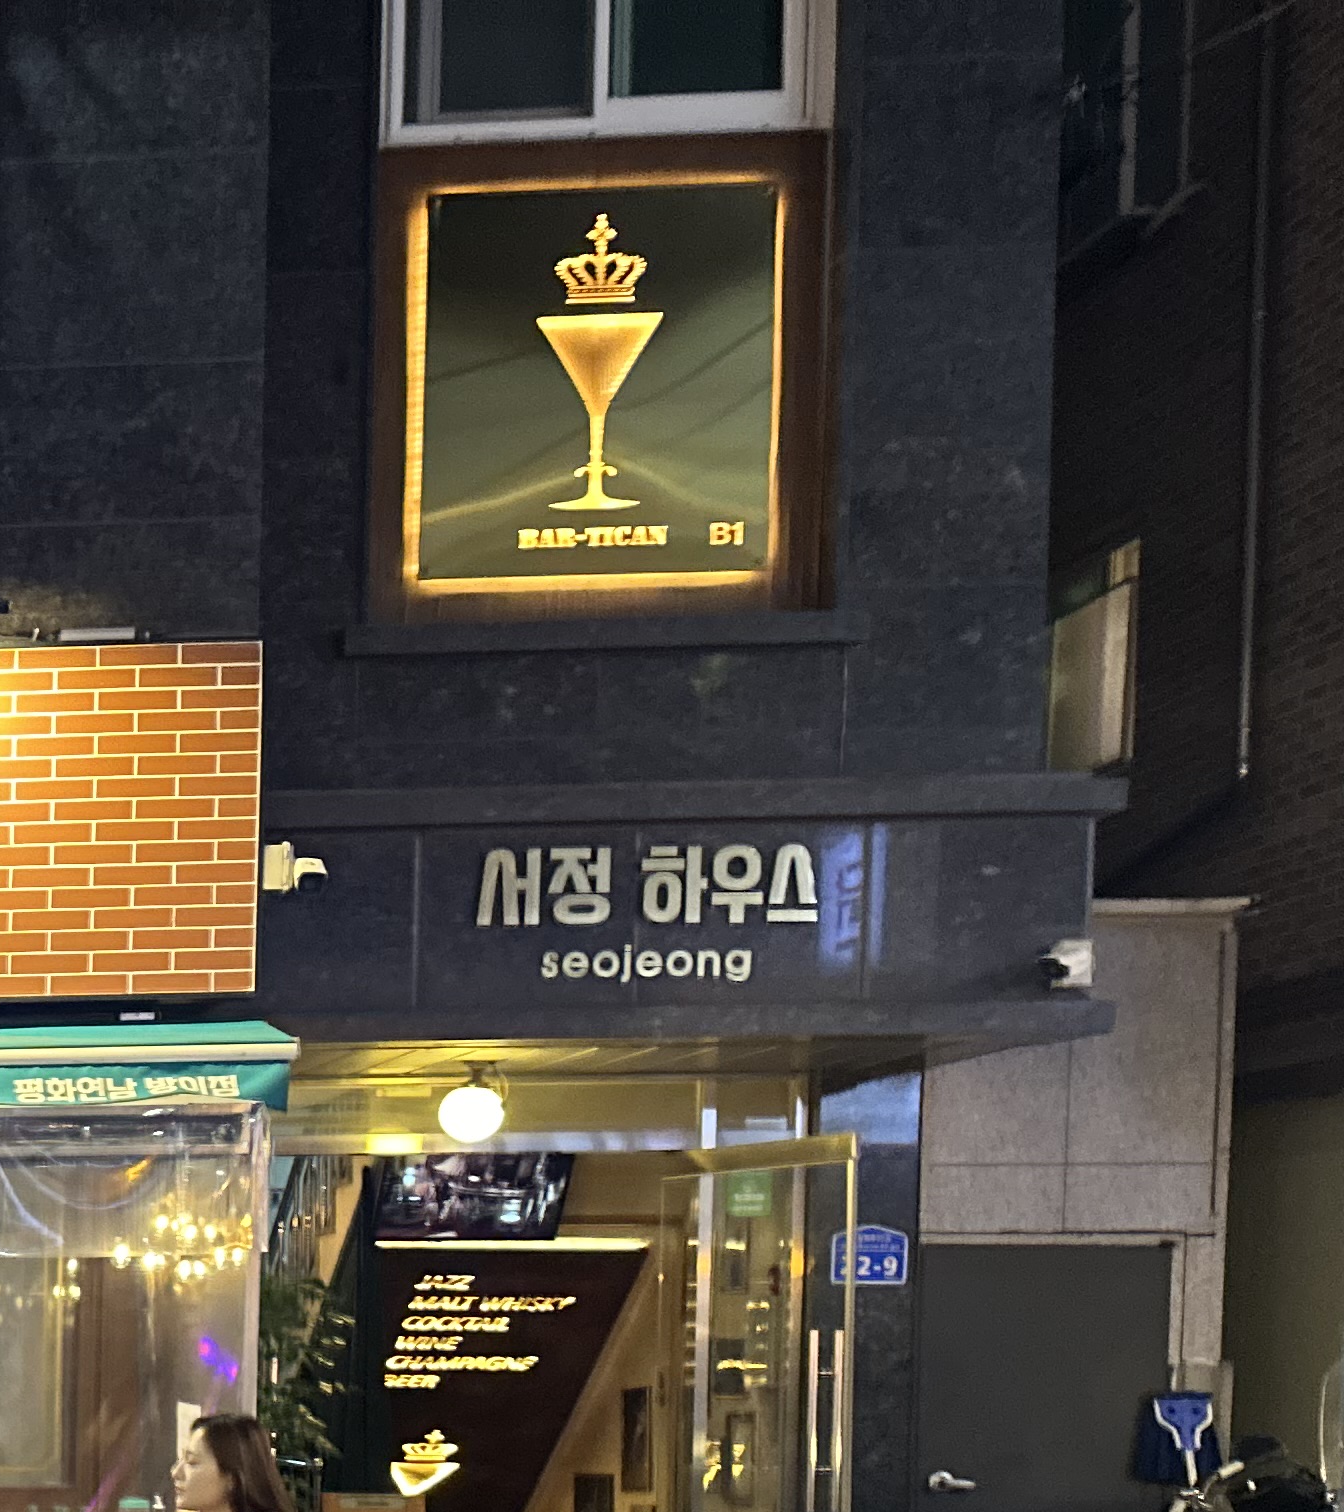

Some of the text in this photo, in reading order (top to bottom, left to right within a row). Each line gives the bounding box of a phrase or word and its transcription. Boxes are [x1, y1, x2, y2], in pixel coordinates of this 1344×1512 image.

[517, 522, 746, 549] BAR-TICAN B1
[475, 846, 612, 928] 서정
[640, 843, 819, 925] 하우스
[540, 944, 754, 984] seojeong
[13, 1077, 138, 1104] 평화연남
[413, 1274, 476, 1291] JAZZ
[407, 1295, 479, 1312] MALT
[394, 1335, 464, 1351] WINE
[385, 1355, 540, 1372] CHAMPAGNE
[383, 1374, 441, 1390] BEER
